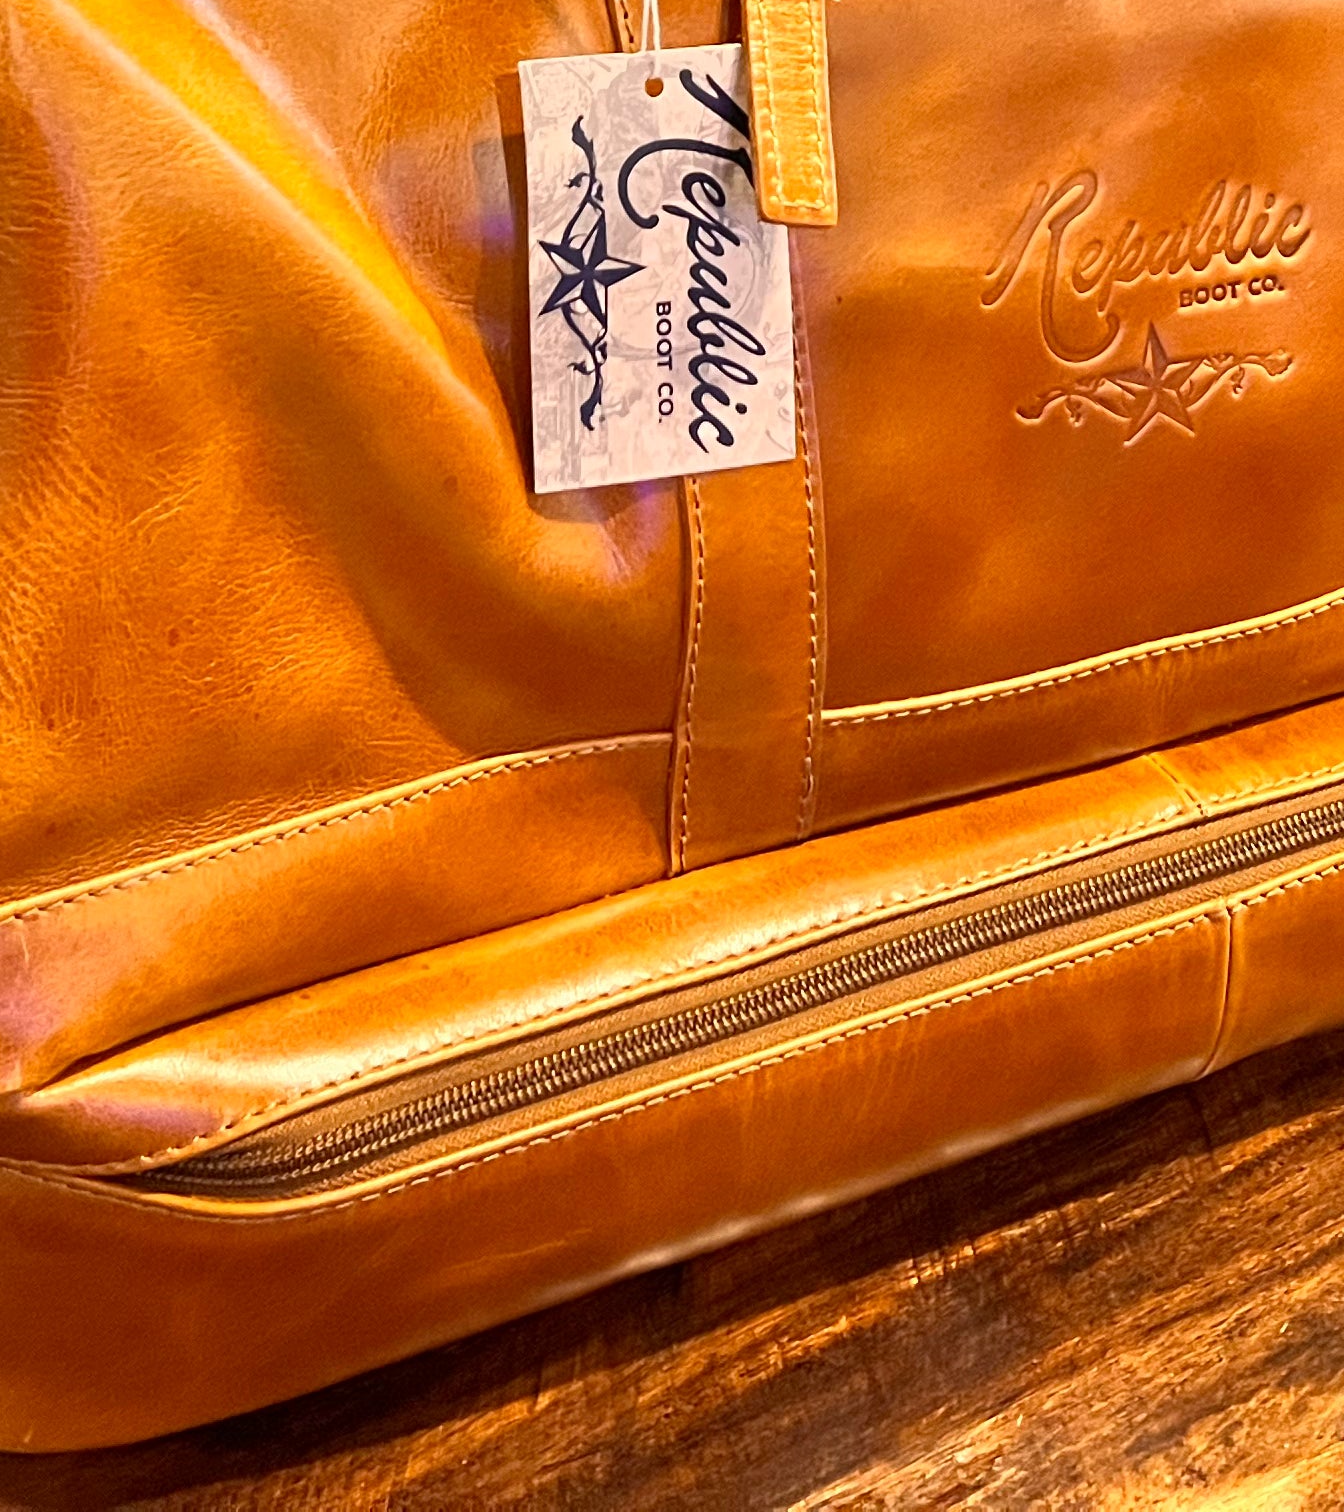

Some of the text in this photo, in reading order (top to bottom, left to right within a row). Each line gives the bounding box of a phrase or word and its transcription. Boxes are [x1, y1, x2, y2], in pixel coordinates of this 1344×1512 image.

[980, 169, 1311, 364] Republic
[1179, 274, 1285, 308] BOOT CO.
[655, 301, 674, 424] BOOT CO.
